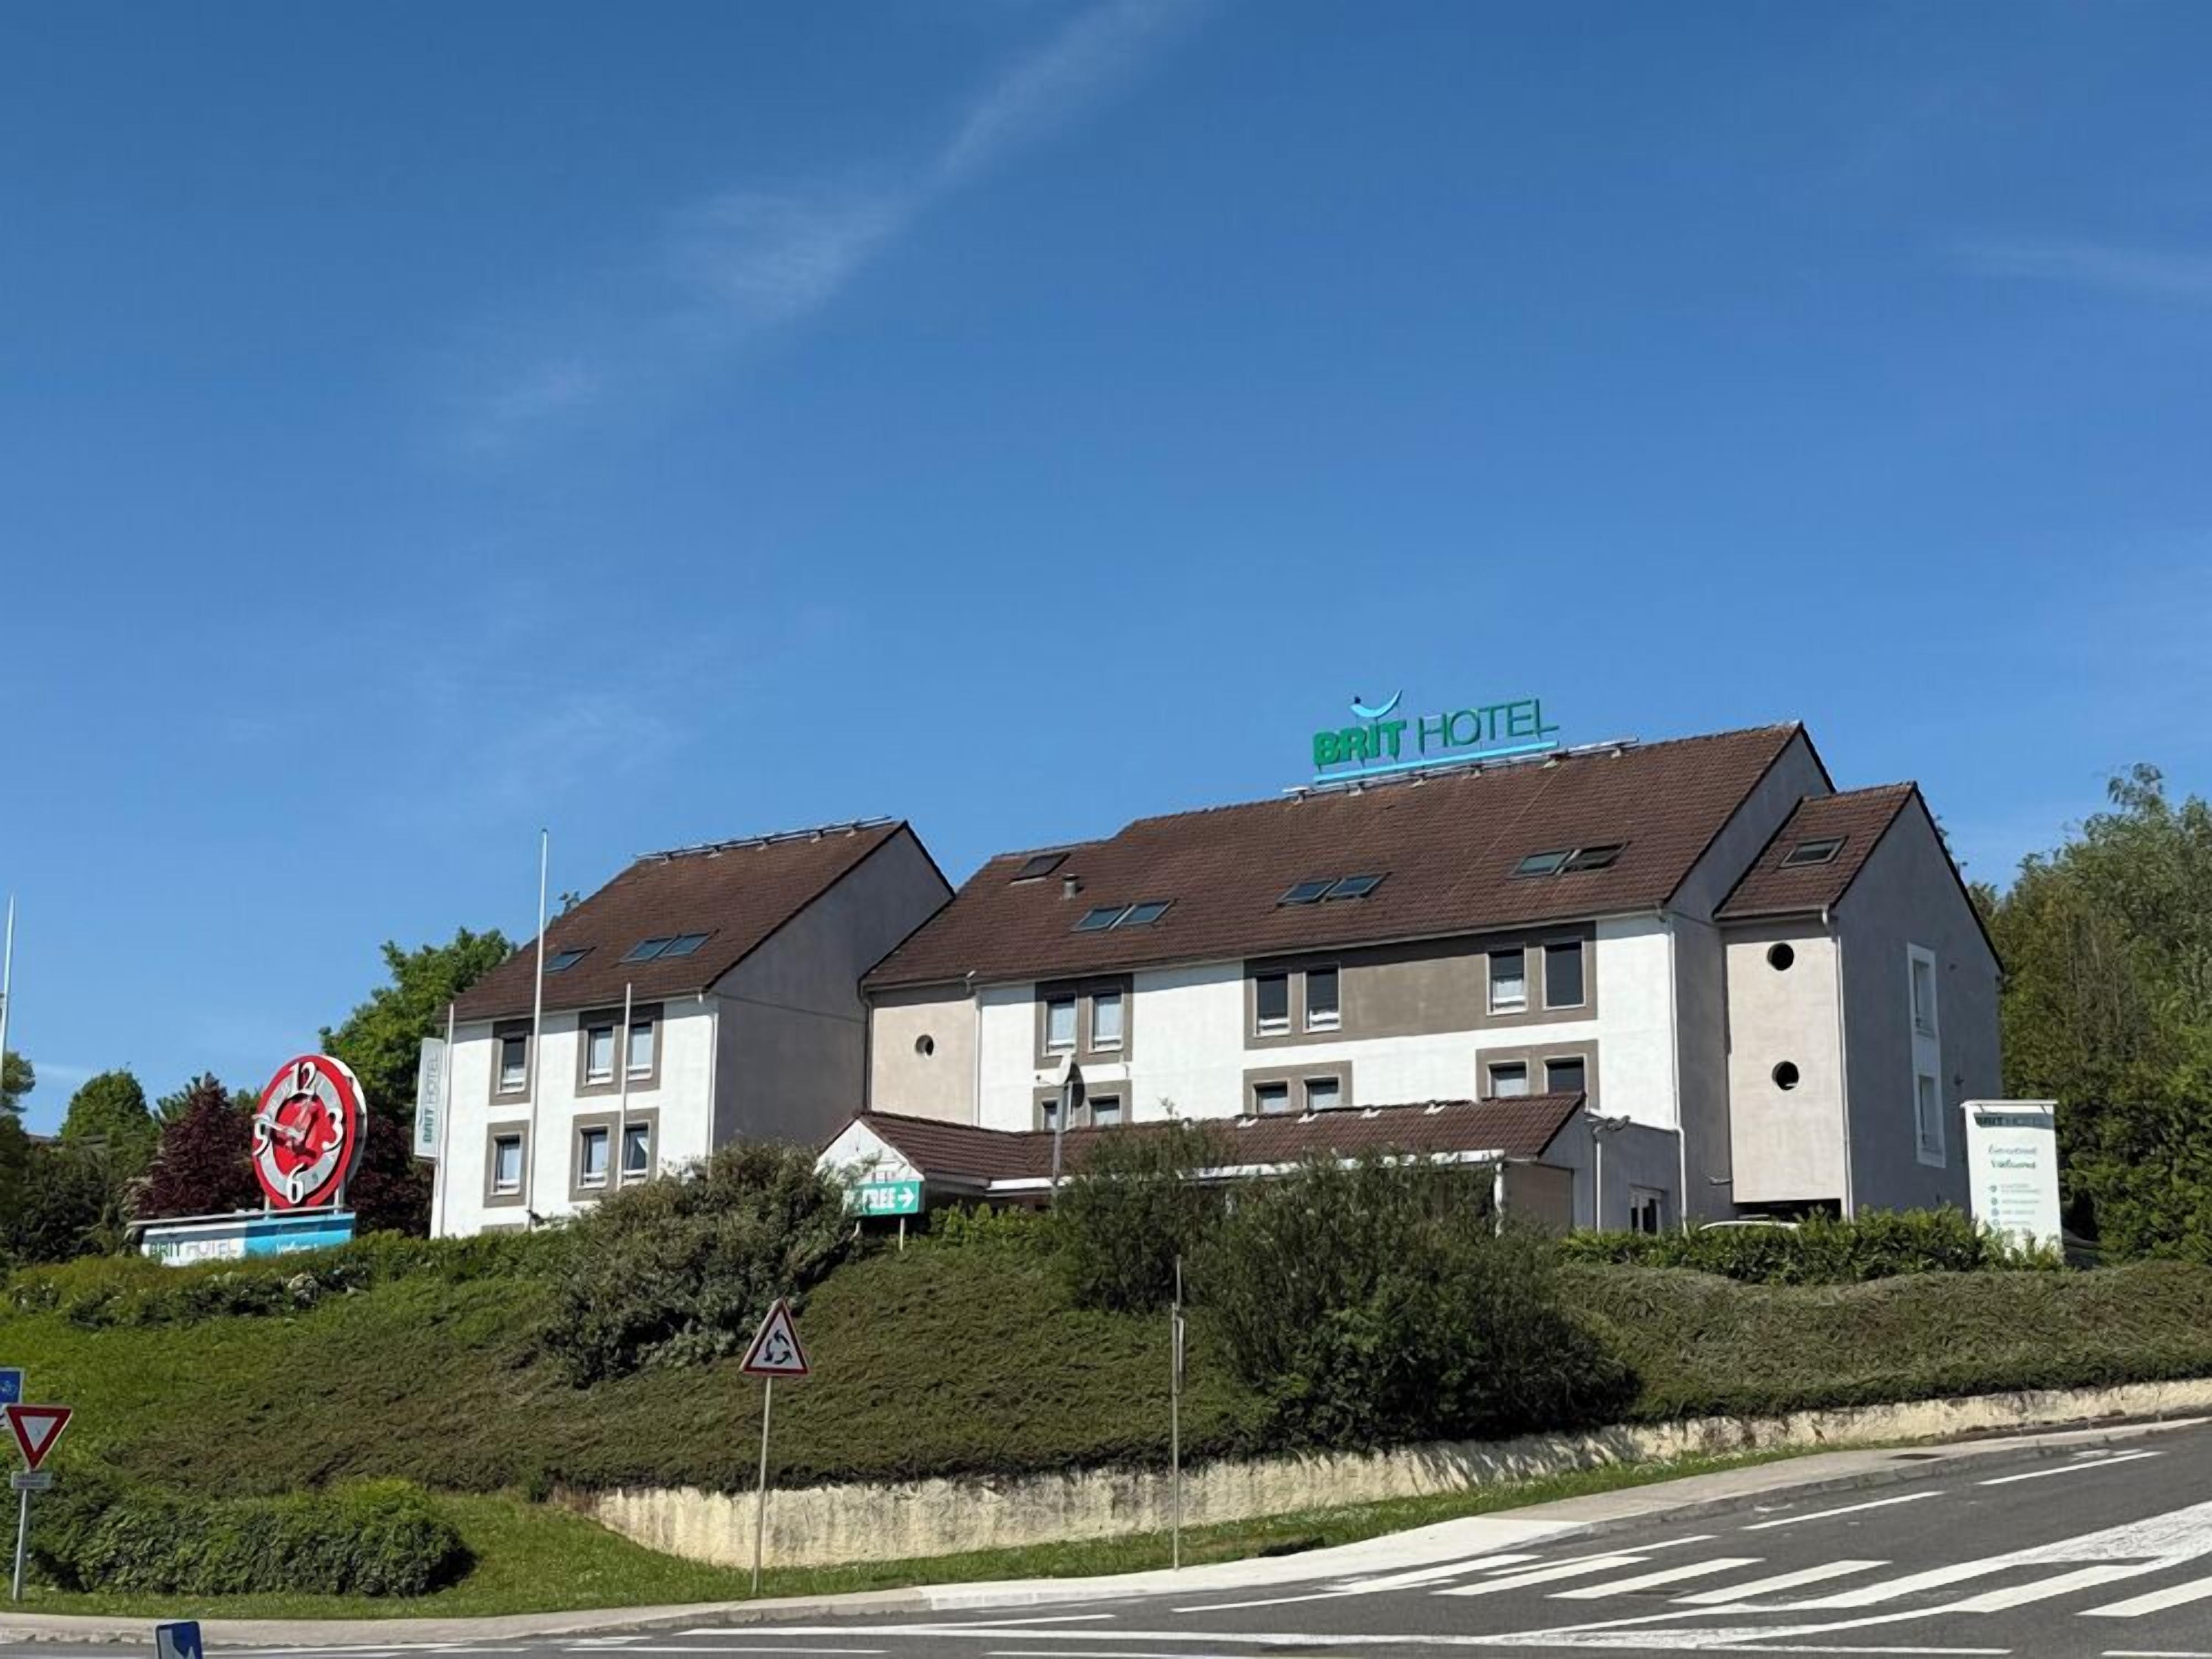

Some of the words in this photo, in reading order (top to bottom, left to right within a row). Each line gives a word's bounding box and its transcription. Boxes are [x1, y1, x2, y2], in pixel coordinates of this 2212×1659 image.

[1313, 720, 1407, 766] BRIT
[1418, 698, 1560, 751] HOTEL
[289, 1061, 317, 1096] 12
[322, 1108, 343, 1149] 3
[286, 1162, 305, 1204] 6
